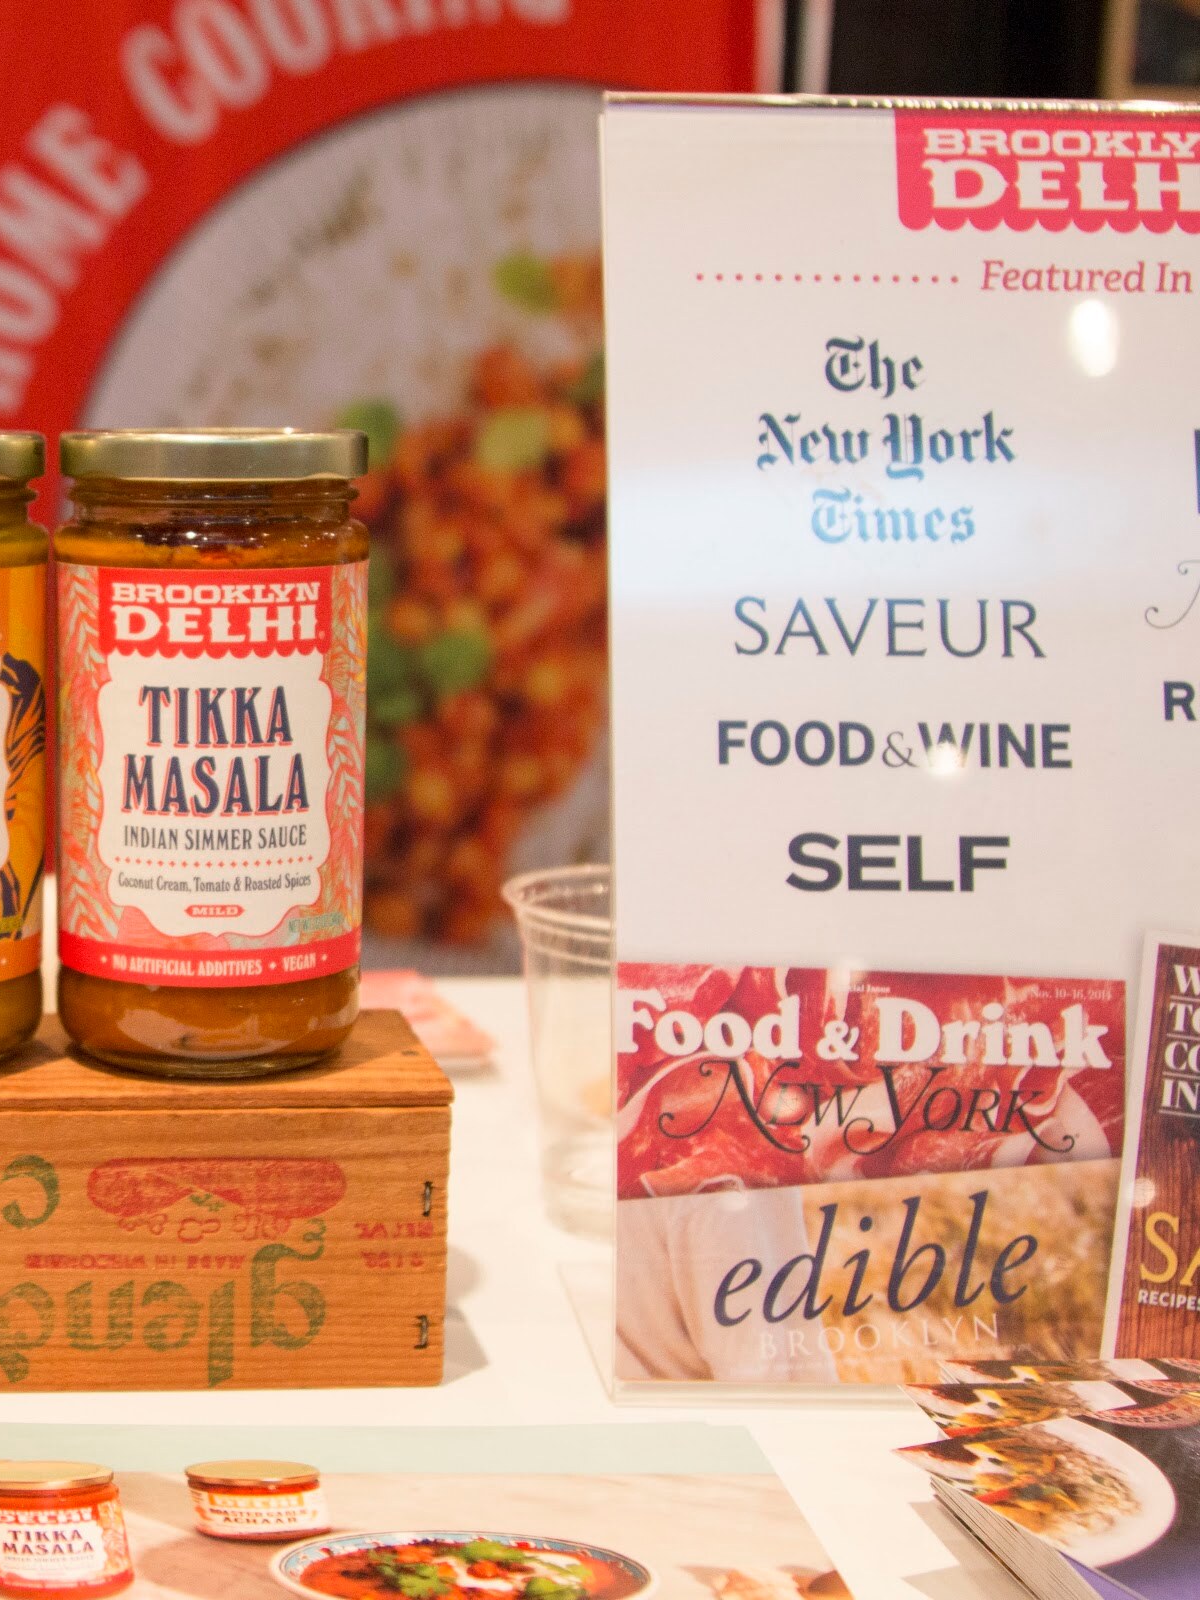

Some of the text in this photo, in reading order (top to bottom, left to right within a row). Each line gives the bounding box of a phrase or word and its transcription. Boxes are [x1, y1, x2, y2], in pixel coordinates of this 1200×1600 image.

[922, 160, 1200, 212] DELH
[980, 260, 1193, 293] Featured In
[824, 335, 925, 398] The
[757, 411, 1017, 482] New York
[811, 488, 977, 545] Times
[111, 582, 320, 605] BROOKLYN
[111, 605, 317, 643] DELHI
[733, 595, 1047, 658] SAVEUR
[138, 685, 293, 748] TIKKA
[121, 753, 309, 817] MASALA
[124, 824, 307, 851] INDIAN SIMMER SAUCE
[118, 871, 311, 893] Coconut Cream, Tomato & Roasted Spices
[786, 832, 1011, 892] SELF
[192, 905, 239, 918] MILD
[113, 953, 316, 977] NO ARTIFICIAL ADDITIVES VEGAN
[617, 988, 1112, 1069] Food & Drink
[23, 1252, 245, 1271] MADE IN WISCONSIN
[714, 1189, 1039, 1327] edible
[758, 1314, 999, 1361] BROOKLYN
[2, 1542, 94, 1556] MASALA
[7, 1528, 83, 1543] TIKKA
